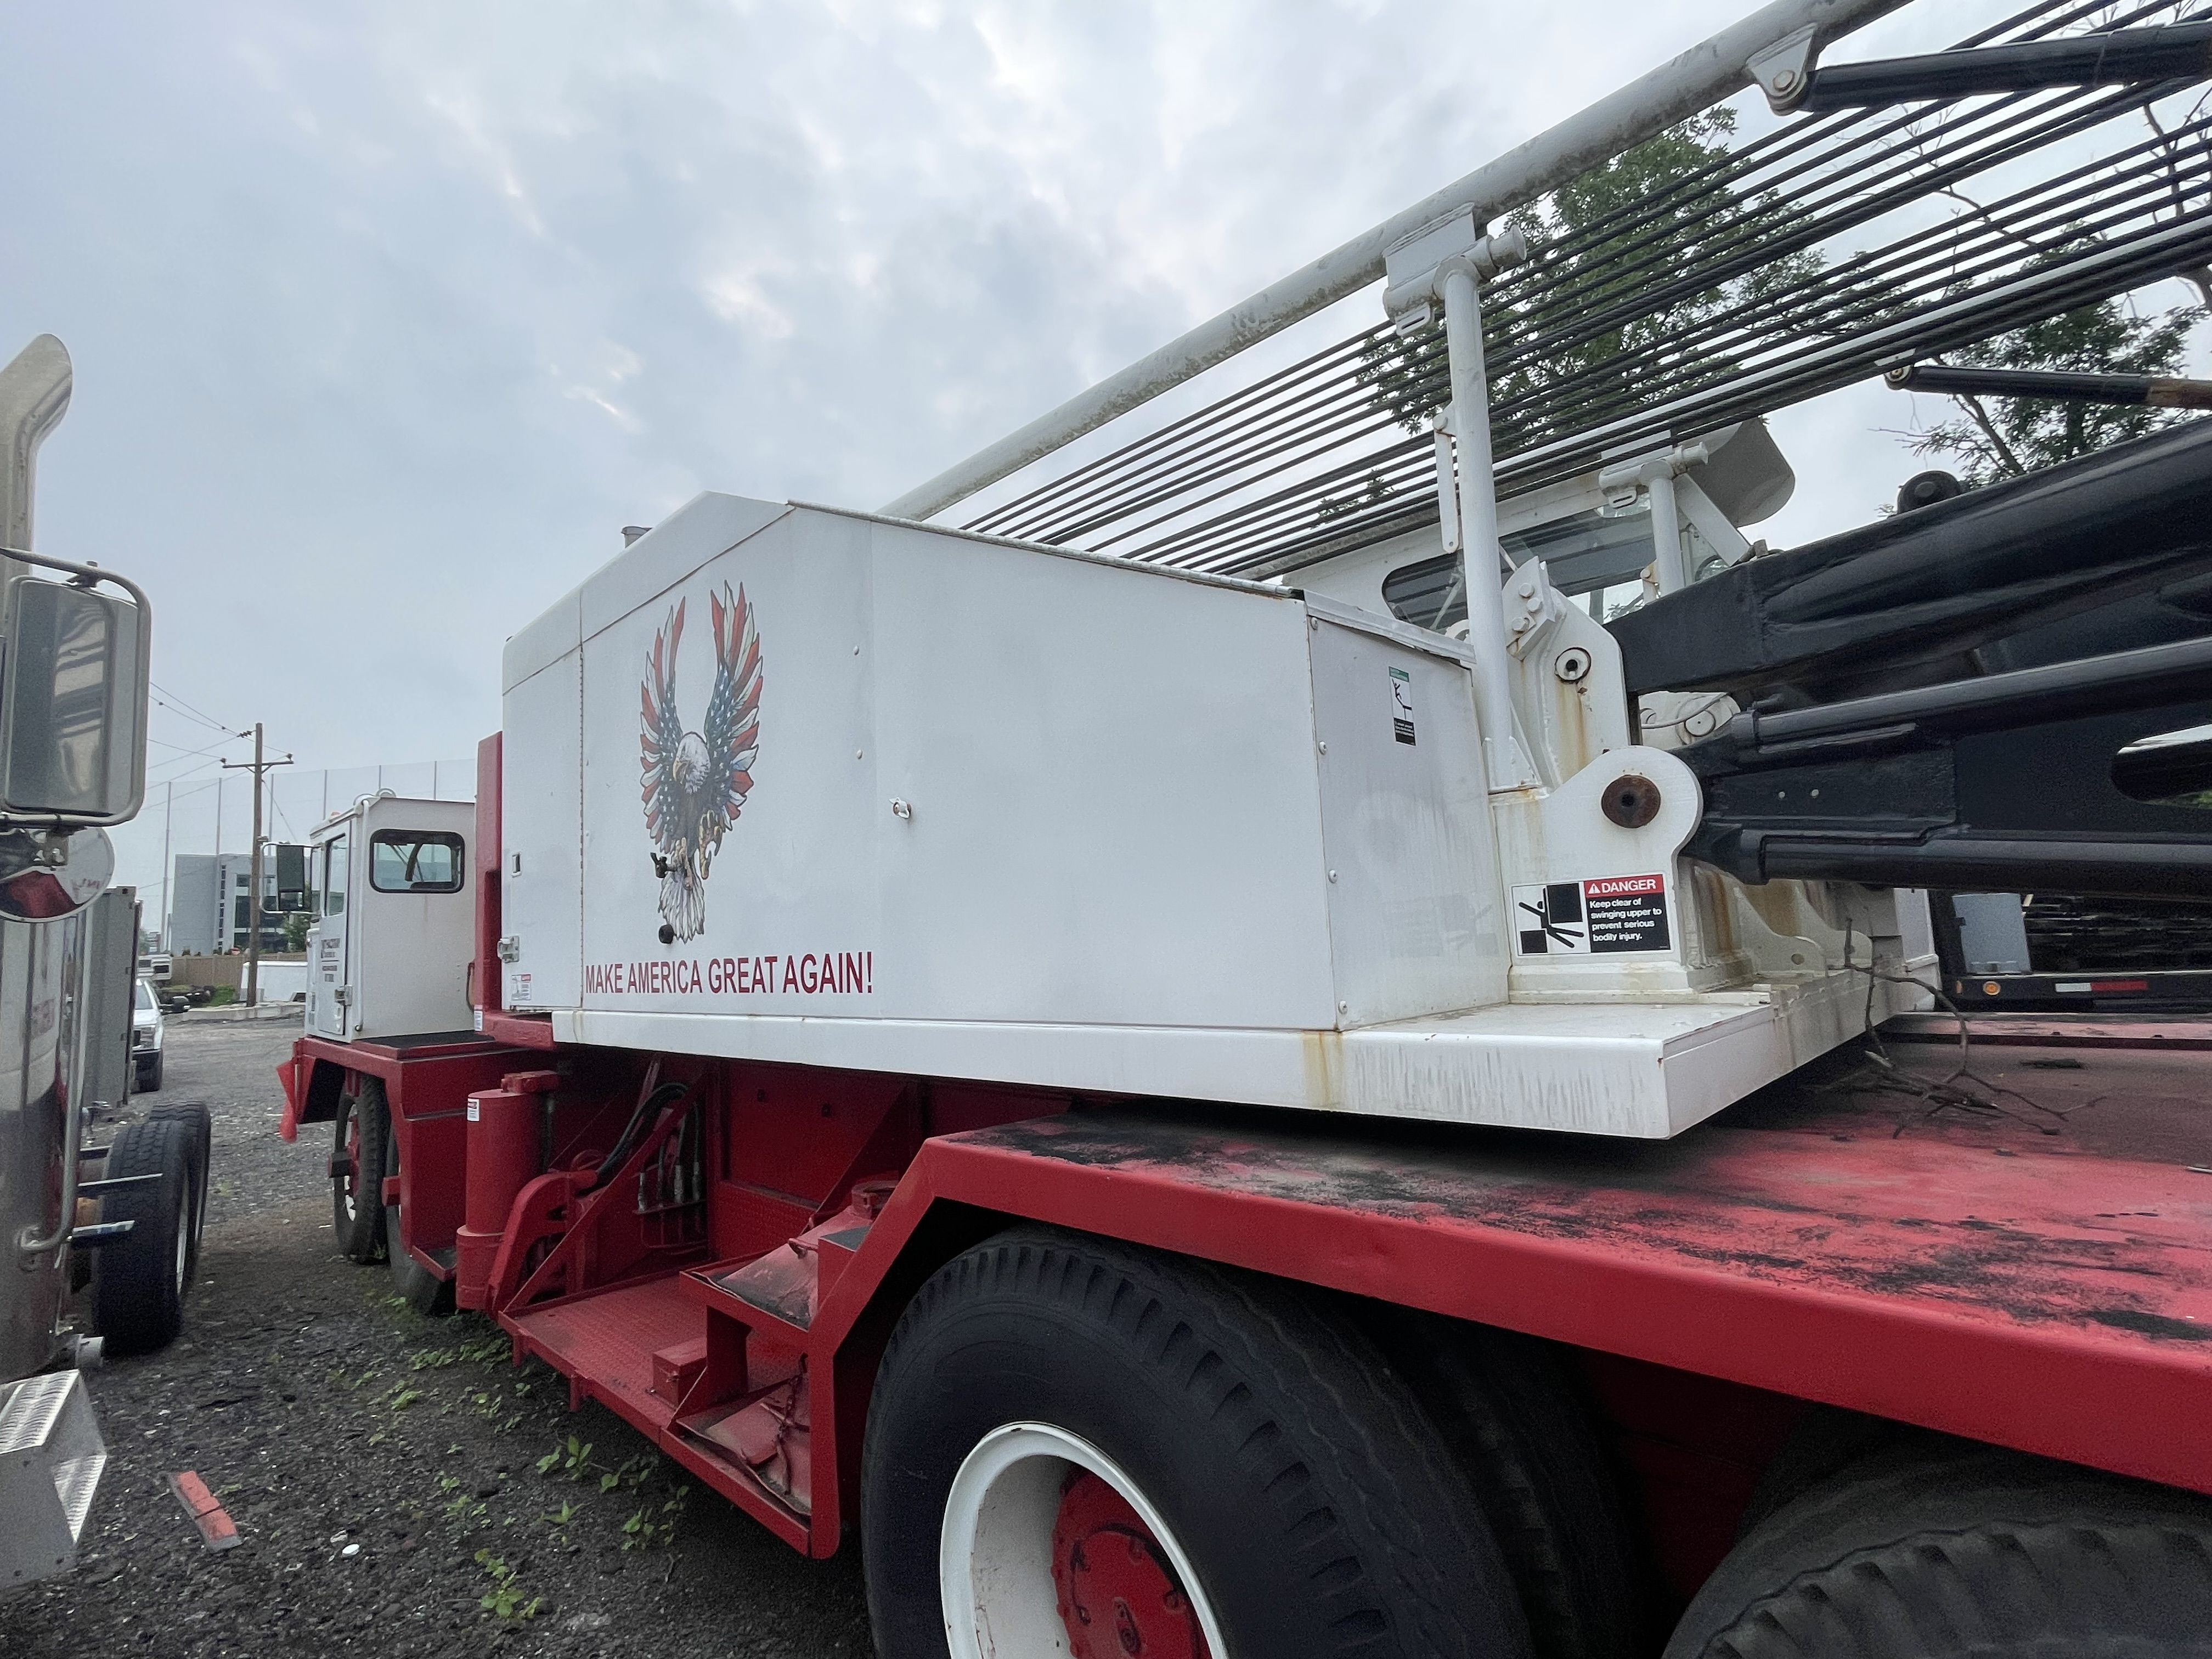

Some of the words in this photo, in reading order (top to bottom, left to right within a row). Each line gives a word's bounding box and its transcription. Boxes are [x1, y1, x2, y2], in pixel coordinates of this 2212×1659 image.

[1601, 879, 1656, 893] DANGER
[1589, 900, 1611, 909] Keep
[1611, 899, 1632, 907] clear
[1590, 910, 1626, 919] swinging
[1627, 908, 1651, 918] upper
[1592, 921, 1622, 931] prevent
[1624, 919, 1655, 928] serious
[1593, 933, 1617, 941] bodily
[1618, 932, 1643, 941] injury.
[585, 963, 623, 994] MAKE
[627, 960, 703, 994] AMERICA
[708, 956, 777, 994] GREAT
[782, 951, 873, 994] AGAIN!
